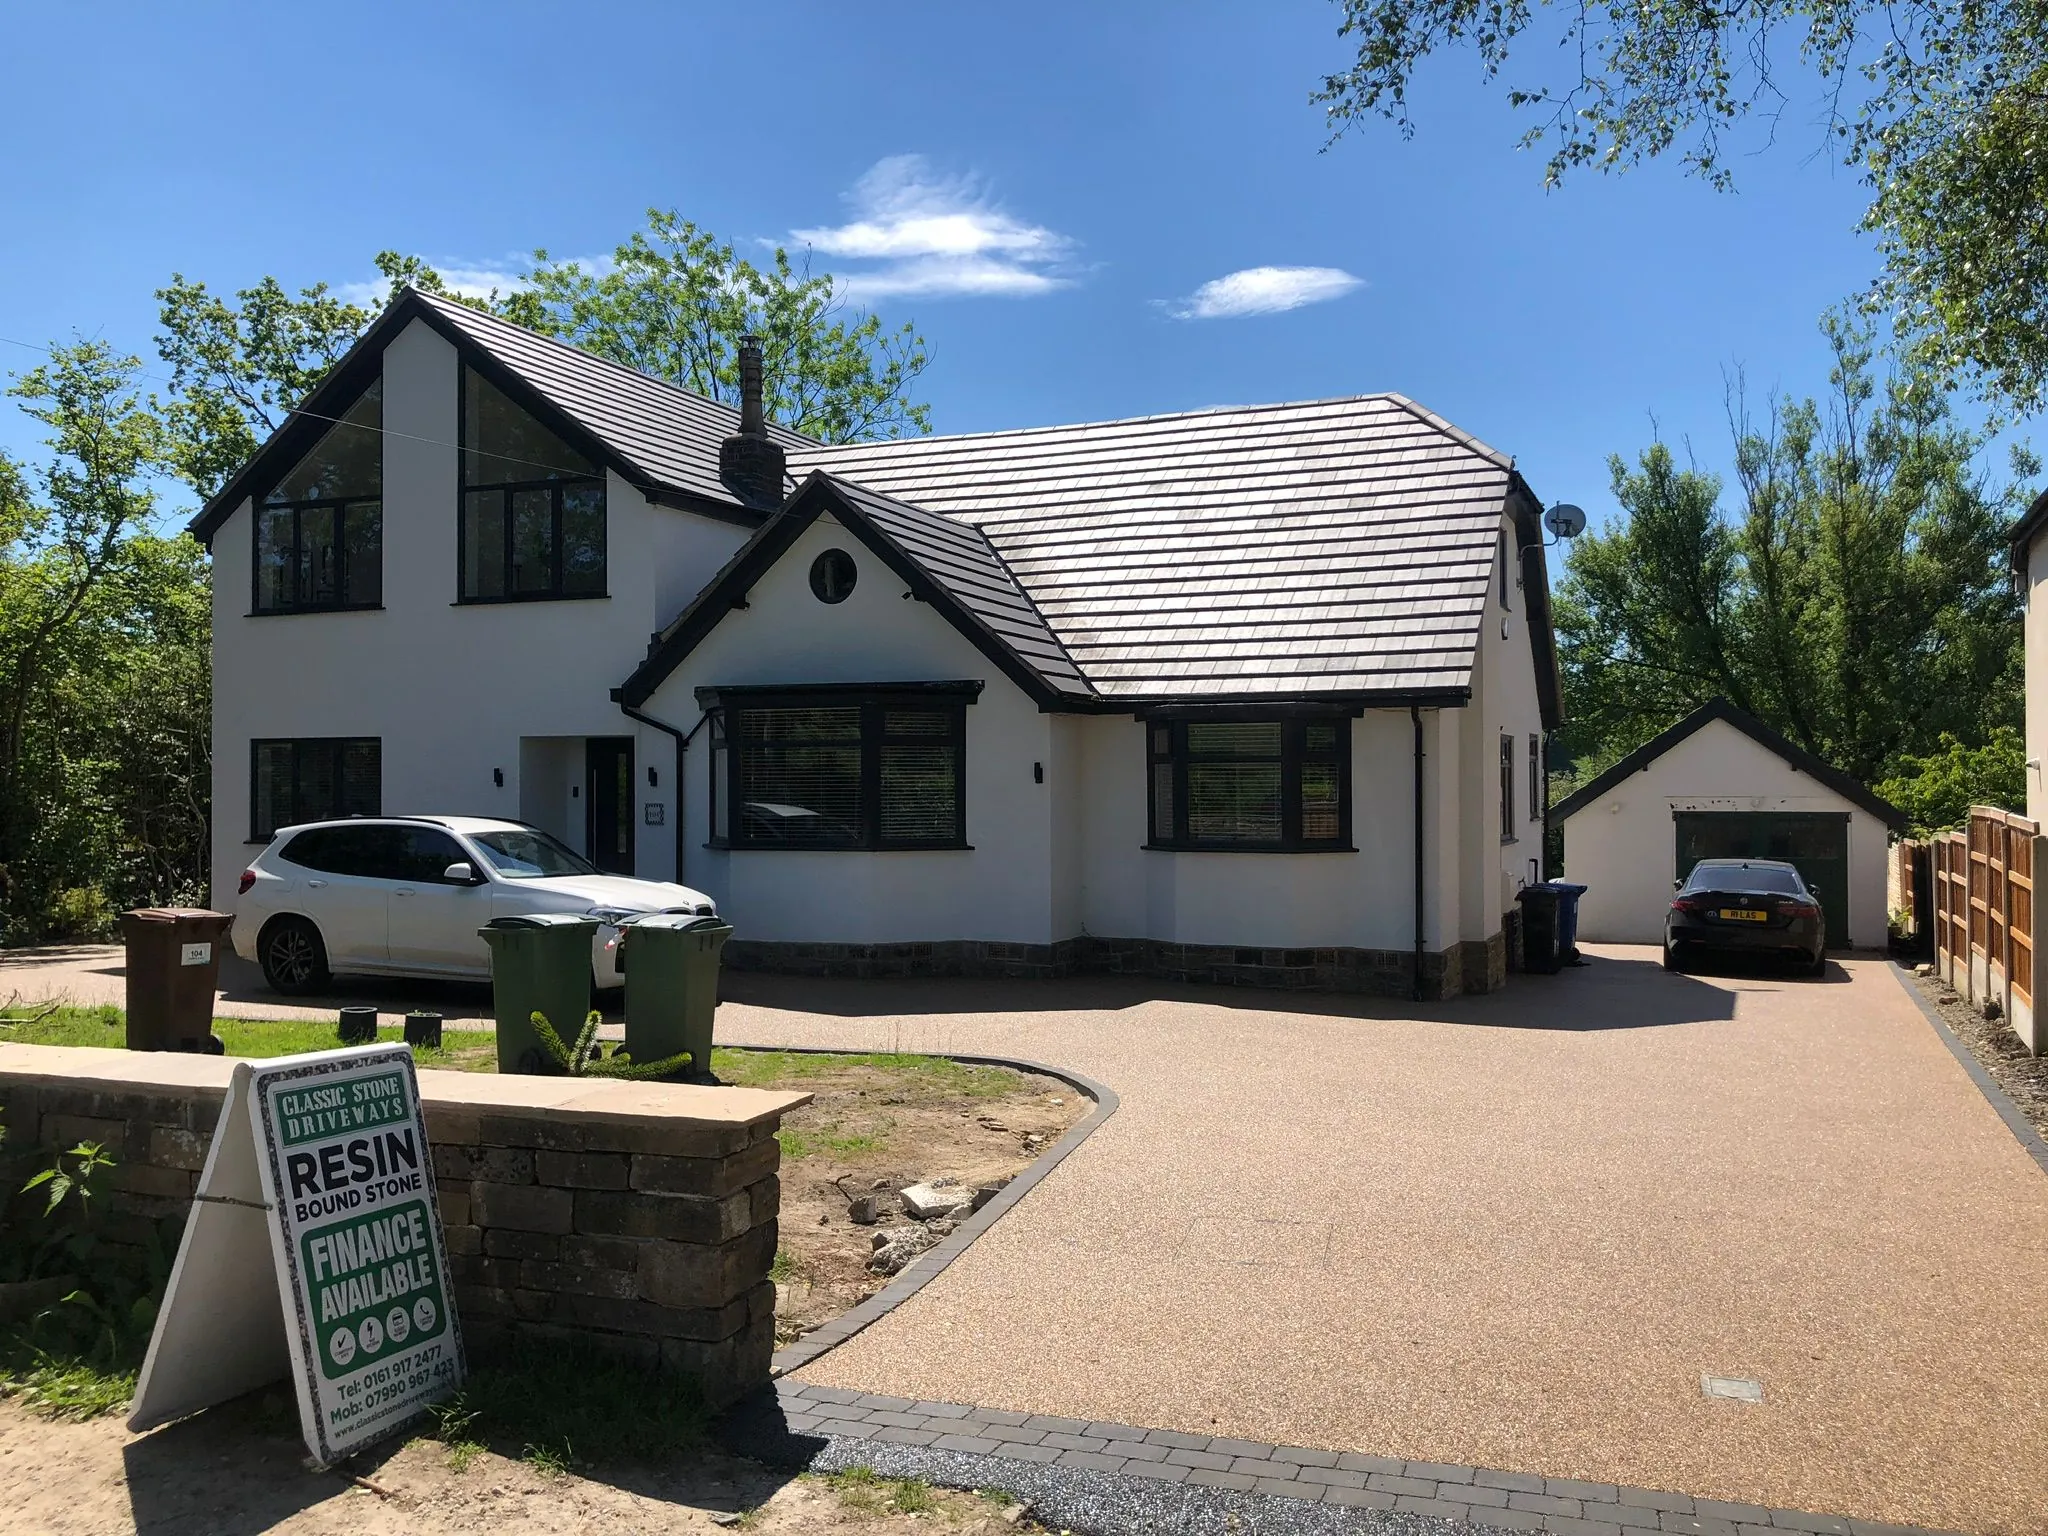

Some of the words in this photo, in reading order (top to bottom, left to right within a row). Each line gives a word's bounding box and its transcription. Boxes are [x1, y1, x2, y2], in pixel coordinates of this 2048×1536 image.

[191, 949, 203, 957] 104
[282, 1086, 346, 1116] CLASSIC
[352, 1077, 400, 1102] STONE
[287, 1097, 403, 1139] DRIVEWAYS
[286, 1127, 418, 1200] RESIN
[295, 1190, 361, 1223] BOUND
[365, 1173, 422, 1203] STONE
[310, 1208, 427, 1282] FINANCE
[321, 1253, 433, 1324] AVAILABLE
[330, 1401, 363, 1425] Mob:
[365, 1380, 406, 1409] 07990
[408, 1368, 430, 1389] 967
[433, 1358, 454, 1378] 423
[337, 1378, 362, 1400] Tel:
[364, 1367, 391, 1390] 0161
[392, 1356, 411, 1377] 917
[414, 1344, 442, 1367] 2477
